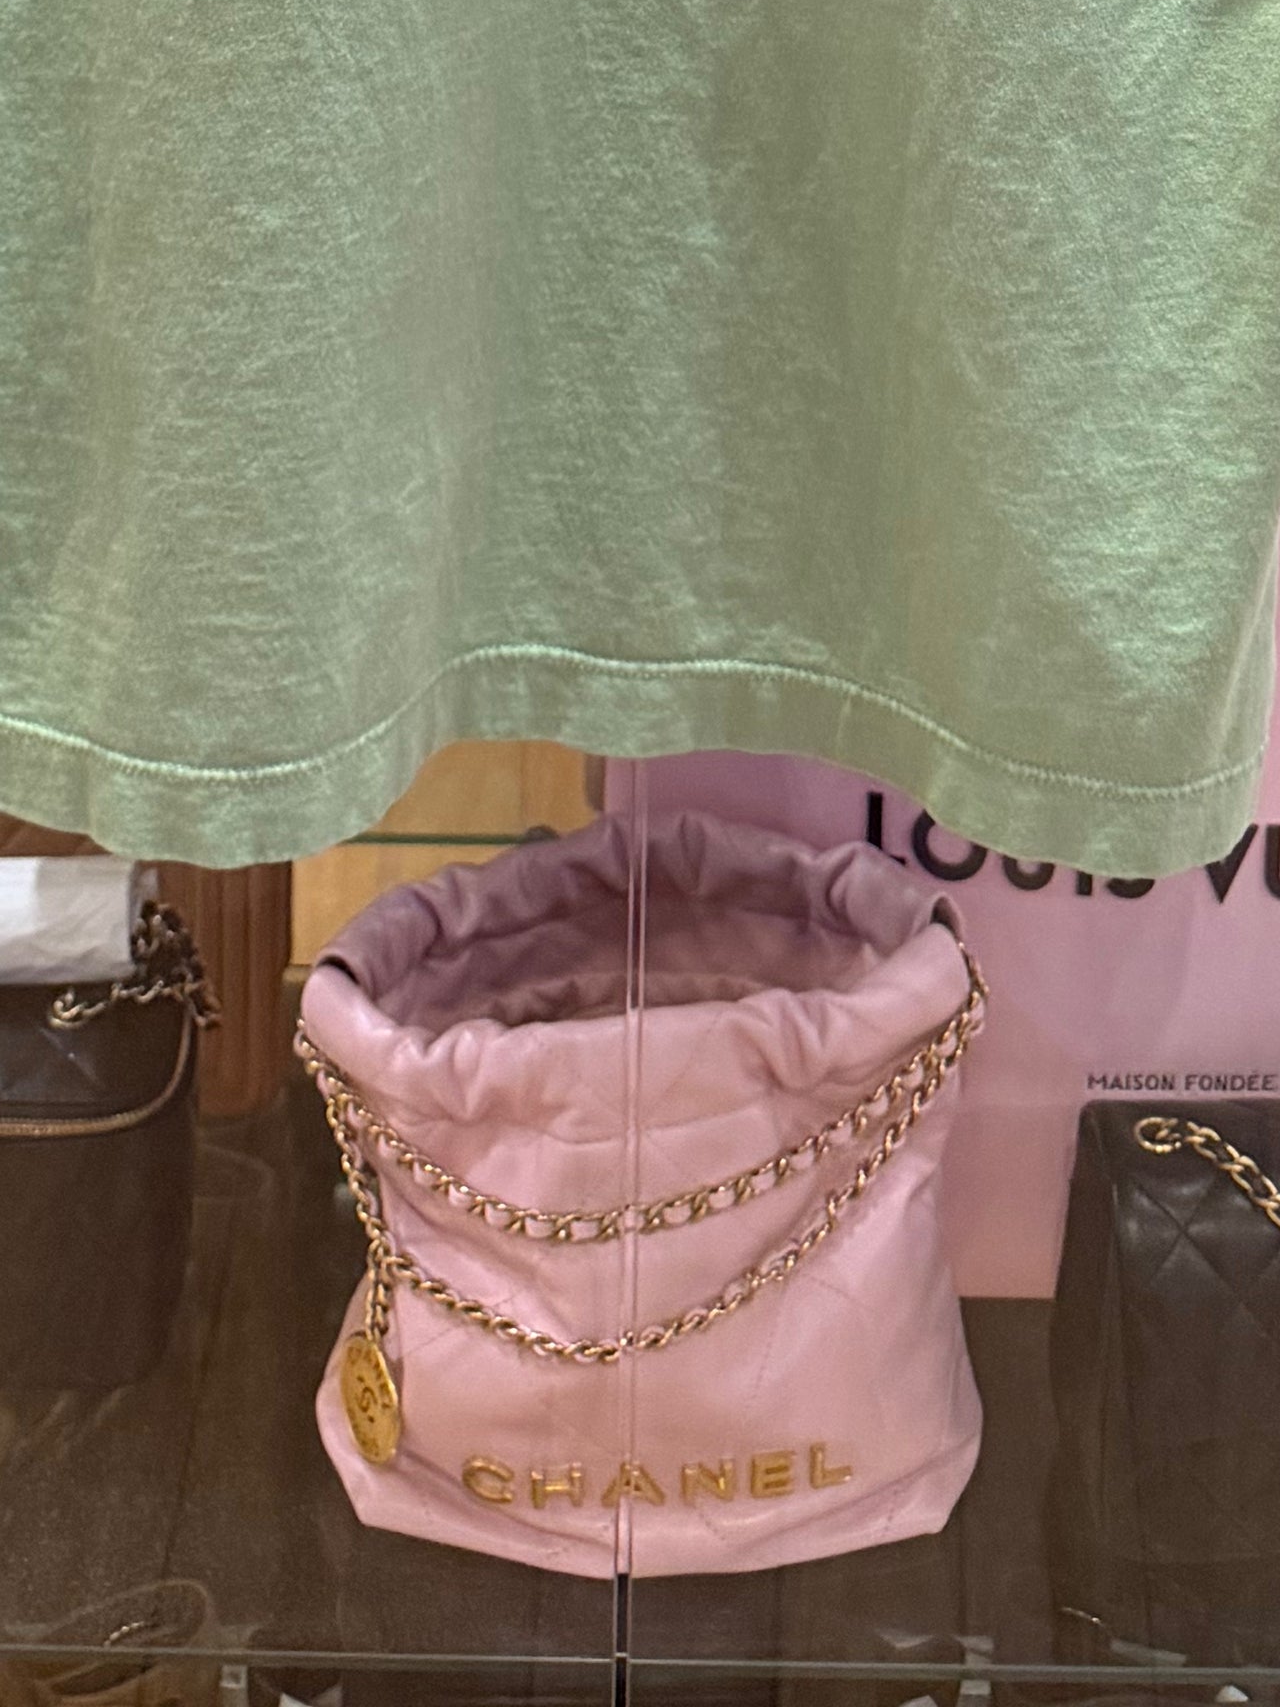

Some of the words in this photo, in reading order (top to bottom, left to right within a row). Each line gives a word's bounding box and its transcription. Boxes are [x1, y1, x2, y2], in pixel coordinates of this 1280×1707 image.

[1086, 1073, 1176, 1091] MAISON
[1184, 1071, 1276, 1091] FONDÉE
[461, 1441, 854, 1509] CHANEL
